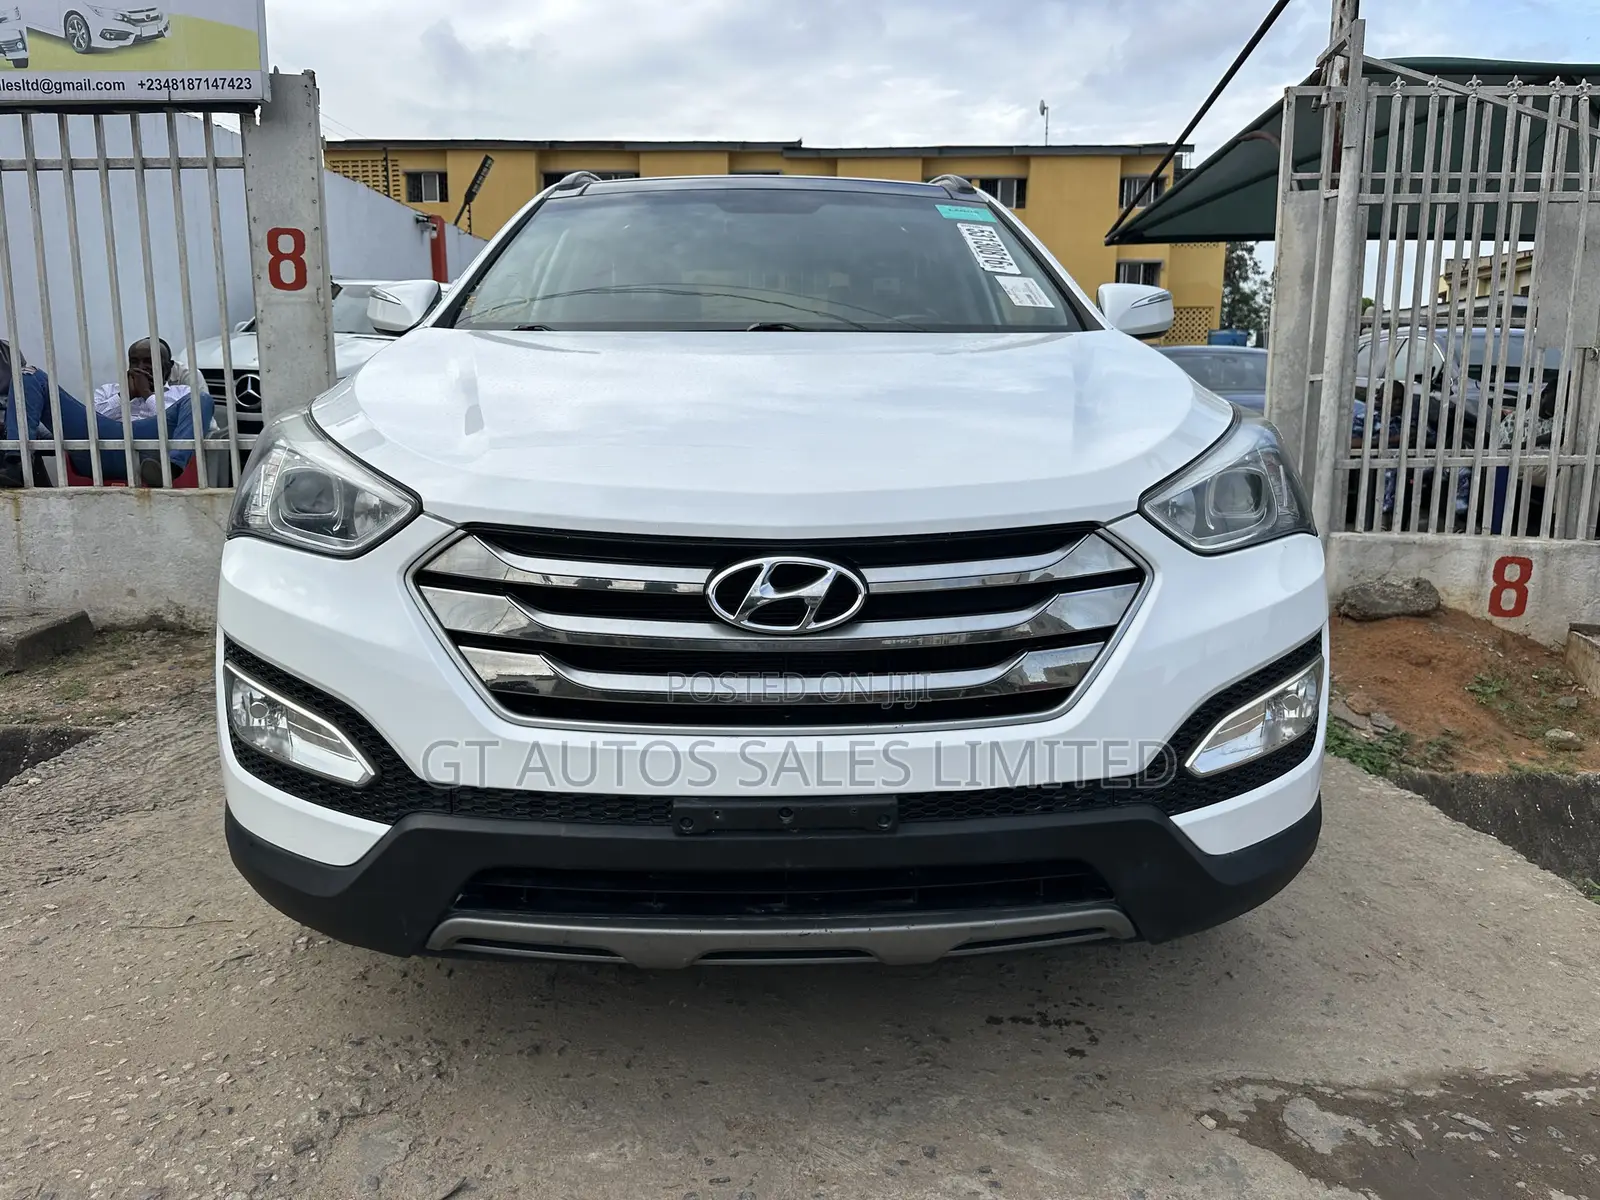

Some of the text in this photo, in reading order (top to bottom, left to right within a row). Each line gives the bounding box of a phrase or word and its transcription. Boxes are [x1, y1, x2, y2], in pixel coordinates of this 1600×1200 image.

[0, 77, 252, 94] lesltd@gmail.com +2348187147423
[267, 227, 307, 291] 8
[1488, 556, 1533, 618] 8
